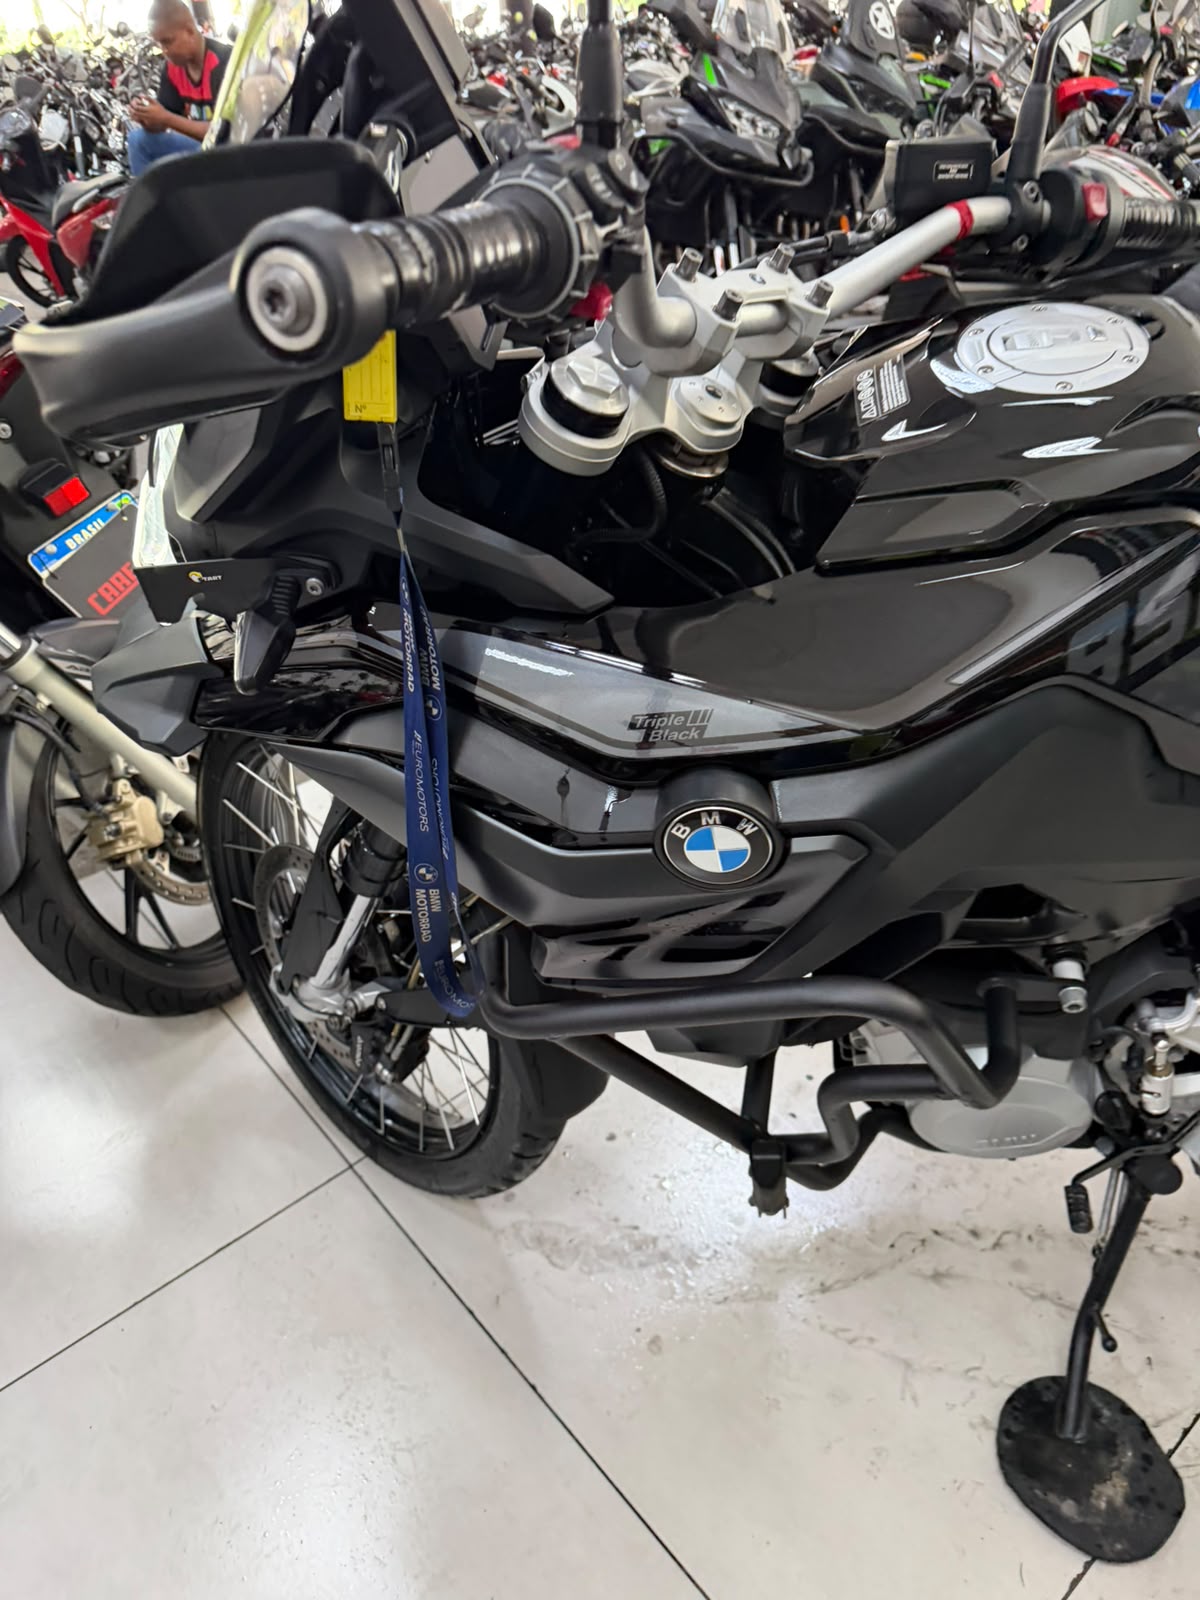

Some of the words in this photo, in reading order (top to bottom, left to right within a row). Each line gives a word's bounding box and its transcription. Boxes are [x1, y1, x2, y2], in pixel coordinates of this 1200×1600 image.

[634, 713, 686, 729] Triple
[648, 727, 701, 742] Black
[670, 810, 760, 840] BMW
[428, 888, 442, 913] BMW
[414, 888, 433, 943] MOTORRAD
